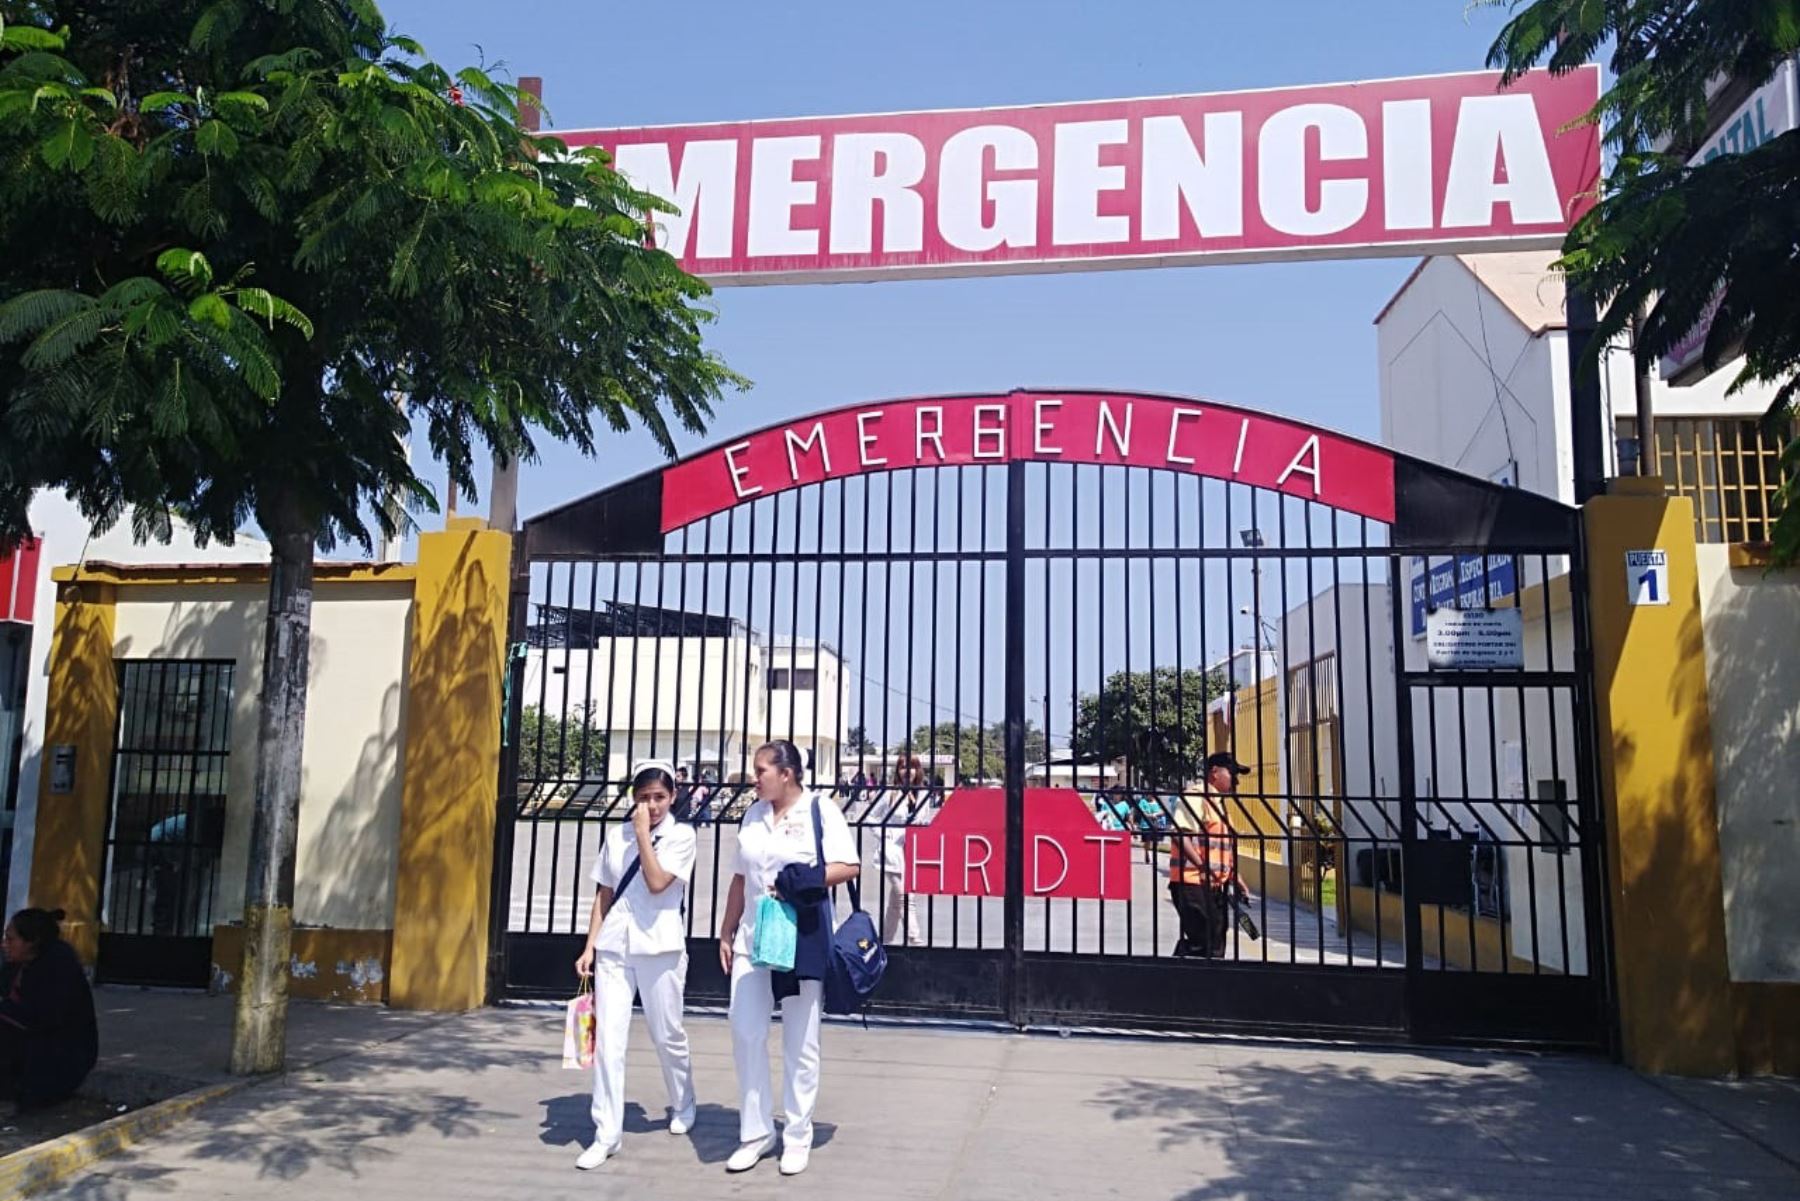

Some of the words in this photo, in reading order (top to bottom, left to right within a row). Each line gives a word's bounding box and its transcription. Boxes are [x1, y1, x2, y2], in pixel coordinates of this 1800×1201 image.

[724, 400, 1321, 498] EMERGENCIA
[1629, 553, 1664, 565] PUERTA
[1638, 569, 1659, 601] 1
